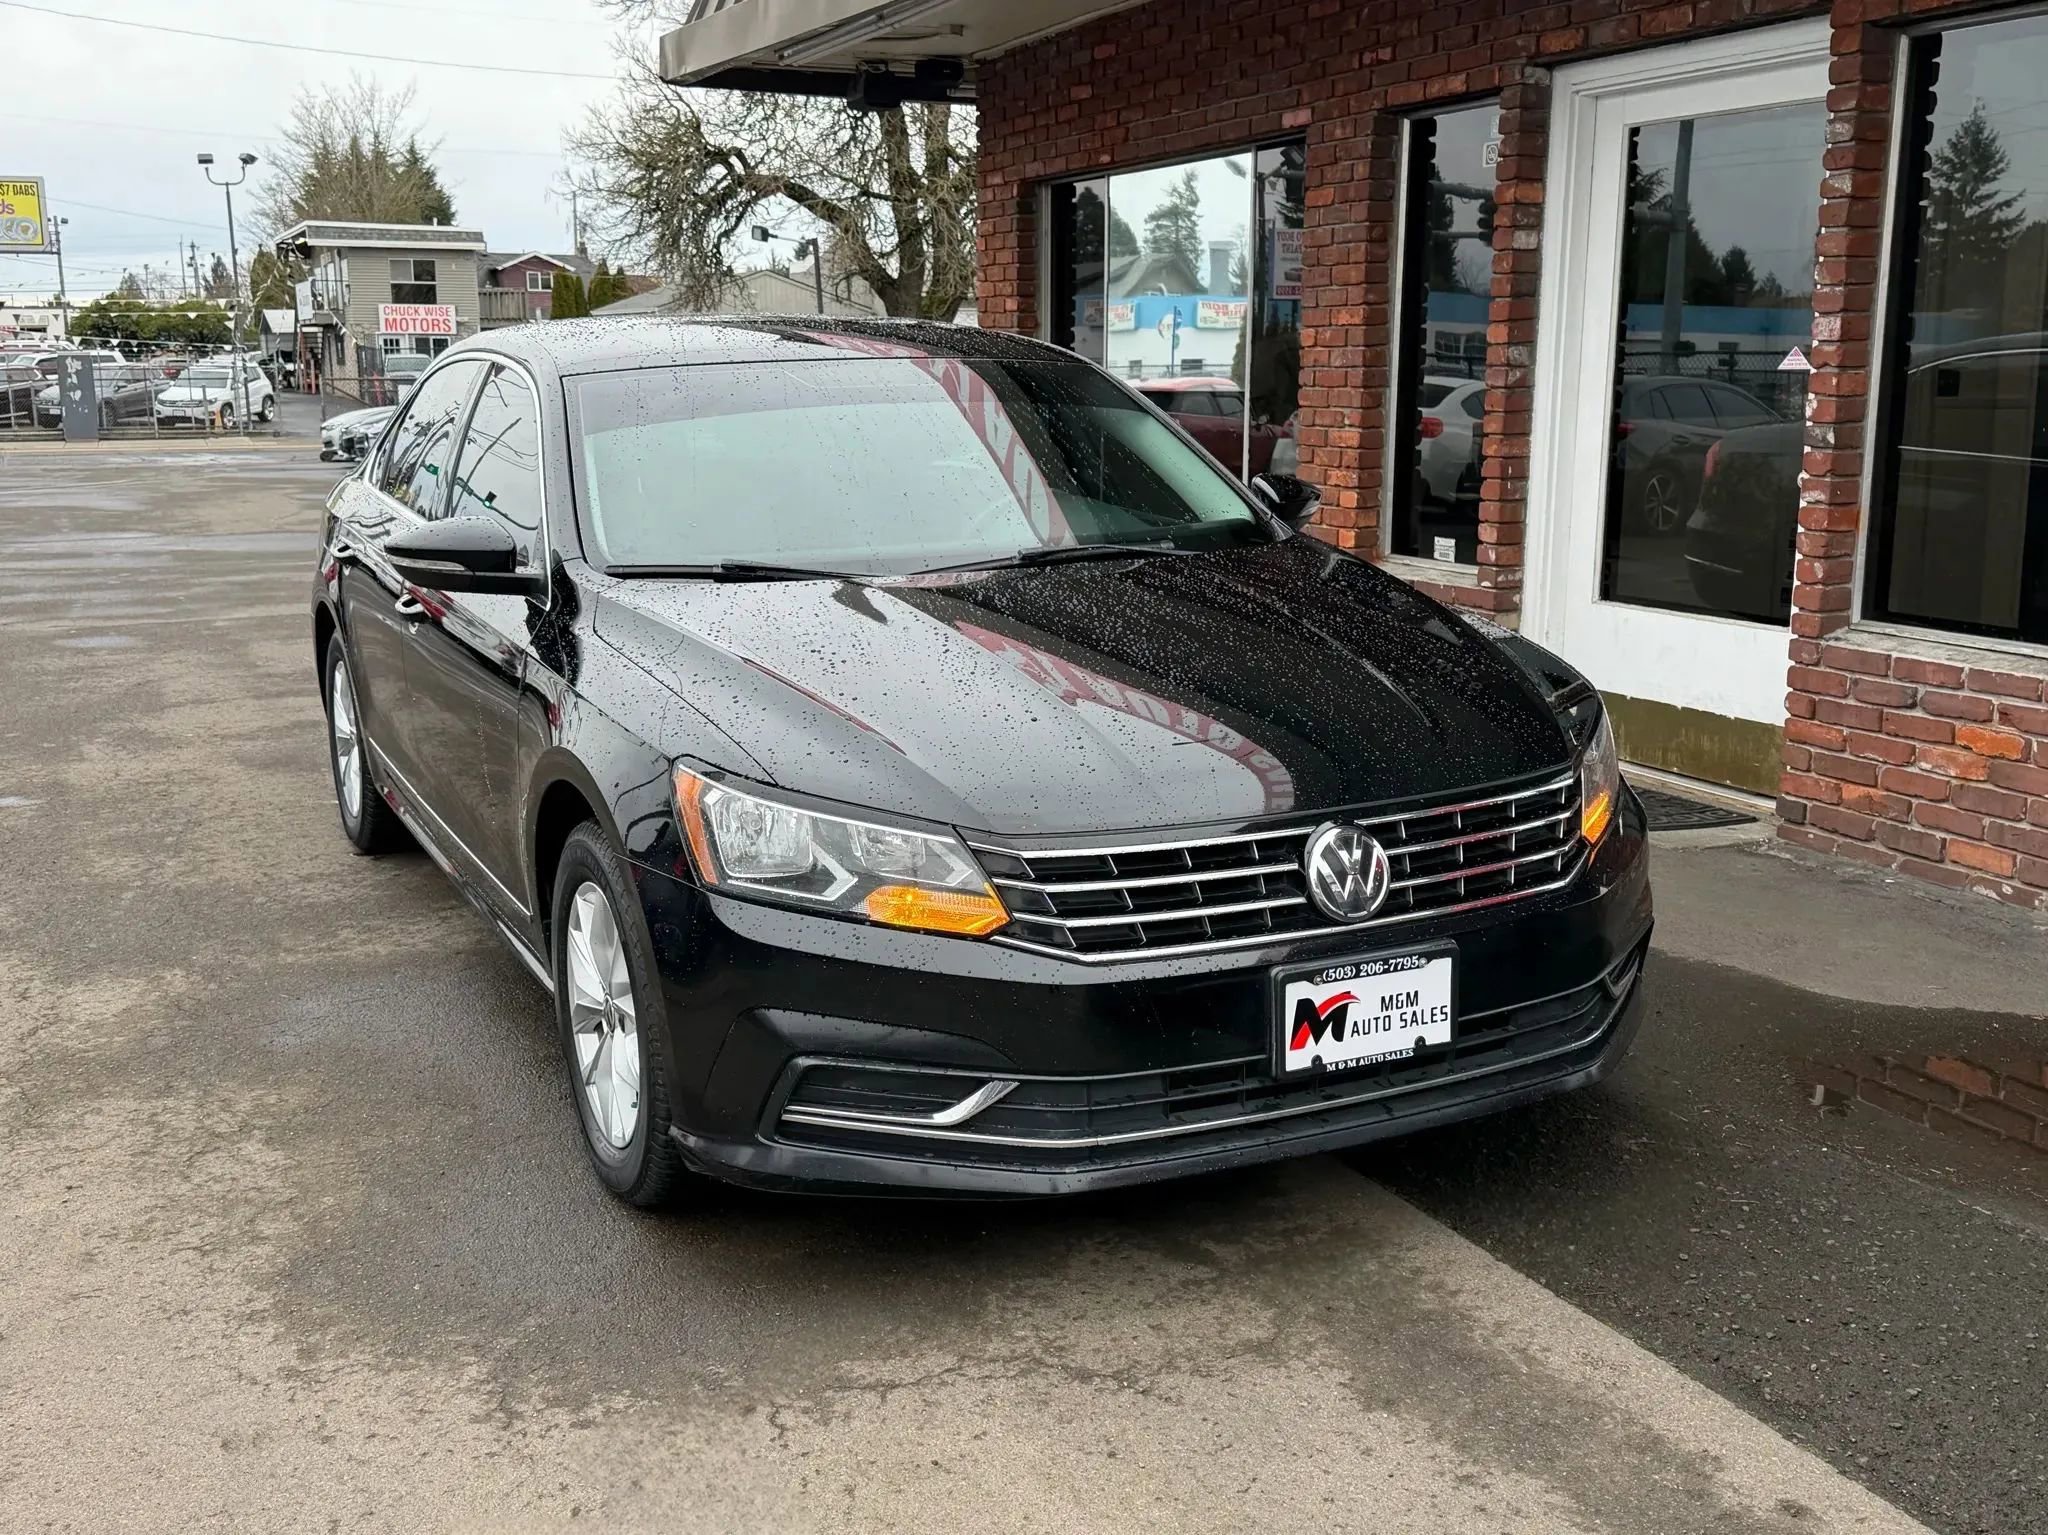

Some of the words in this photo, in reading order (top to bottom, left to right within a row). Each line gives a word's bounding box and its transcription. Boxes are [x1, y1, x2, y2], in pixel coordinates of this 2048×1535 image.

[12, 184, 36, 196] DABS
[383, 305, 421, 317] CHUCK
[423, 306, 452, 317] WISE
[384, 317, 452, 333] MOTORS
[1322, 965, 1356, 982] (503)
[1359, 955, 1420, 977] 206-7795
[1380, 990, 1419, 1013] M&M
[1350, 1014, 1391, 1038] AUTO
[1399, 1005, 1449, 1029] SALES
[1326, 1063, 1337, 1072] M
[1338, 1062, 1346, 1070] &
[1347, 1060, 1357, 1068] M
[1358, 1054, 1384, 1066] AUTO
[1385, 1049, 1415, 1061] SALES
